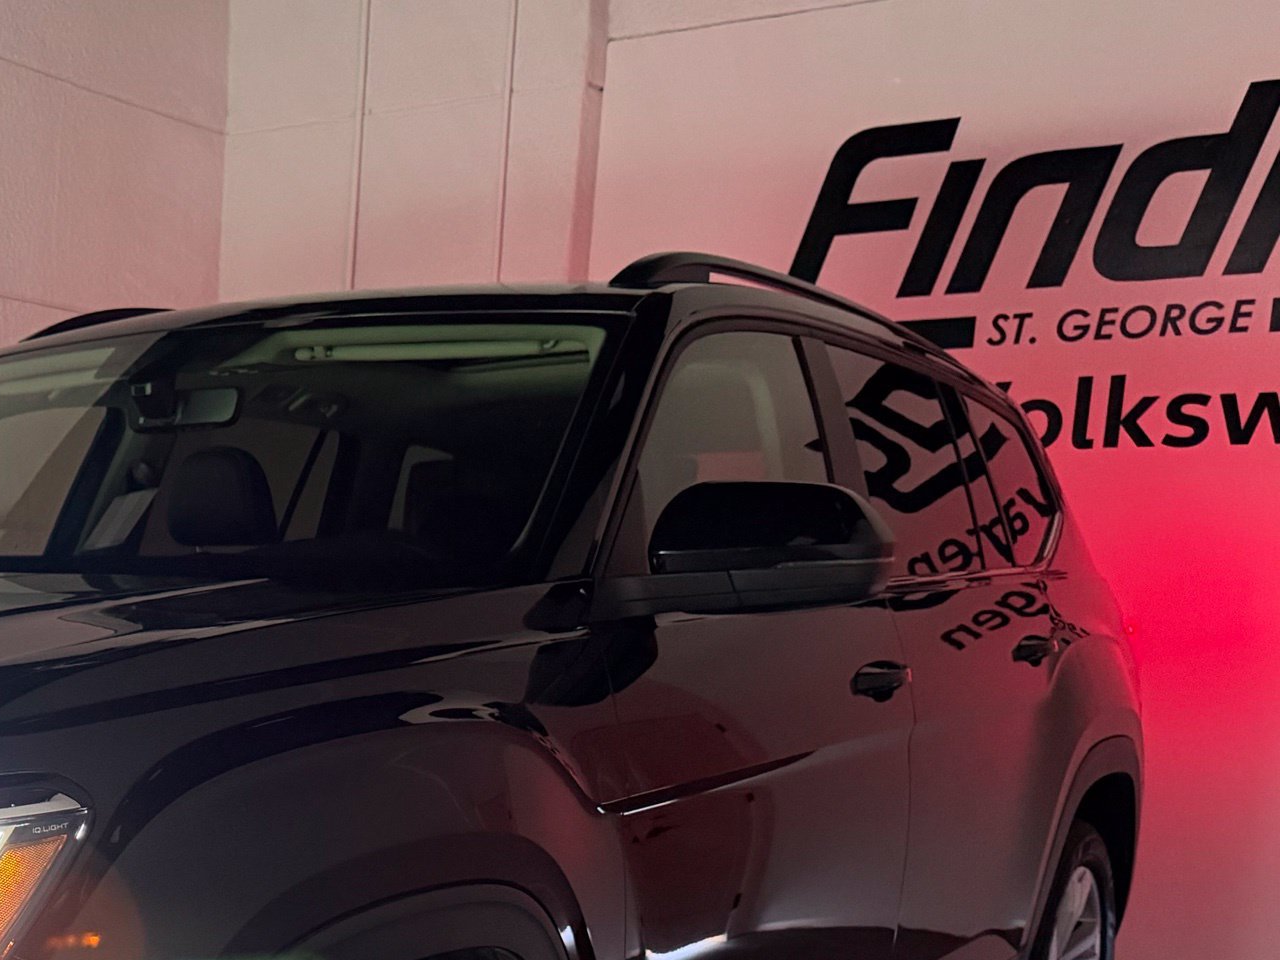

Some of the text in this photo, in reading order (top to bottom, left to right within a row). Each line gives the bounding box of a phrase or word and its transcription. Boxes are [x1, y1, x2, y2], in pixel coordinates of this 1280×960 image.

[986, 299, 1256, 346] ST. GEORGE
[995, 374, 1280, 449] olksw
